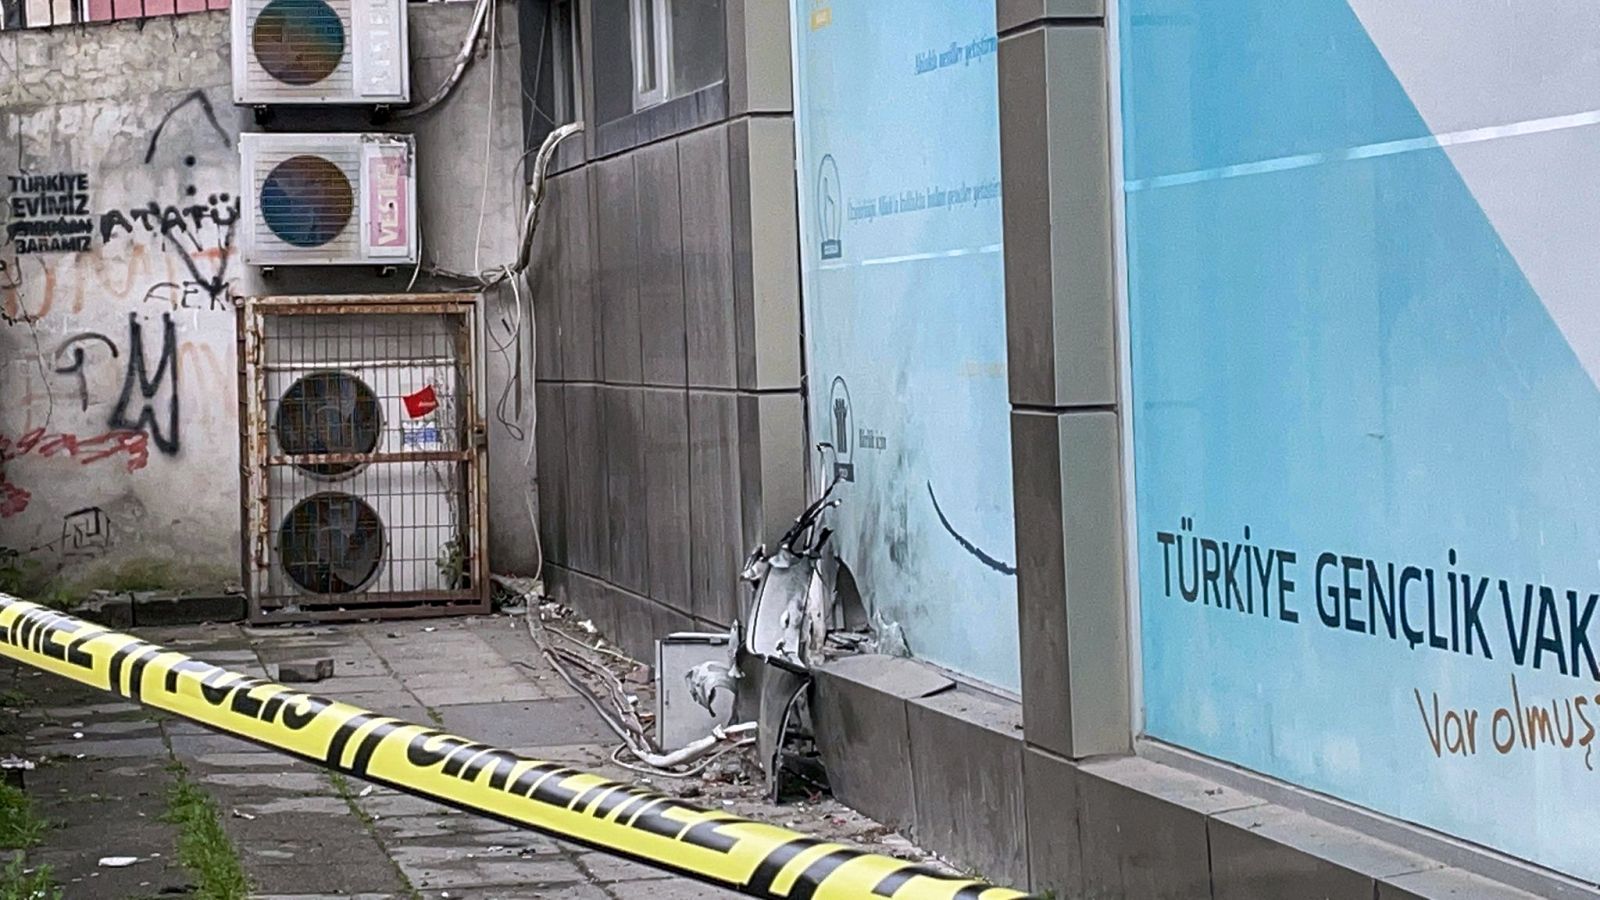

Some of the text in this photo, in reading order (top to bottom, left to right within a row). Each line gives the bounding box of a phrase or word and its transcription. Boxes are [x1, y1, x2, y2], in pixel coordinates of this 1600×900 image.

[99, 194, 241, 244] ATATÜ
[1156, 516, 1600, 682] TÜRKİYE GENÇLİK VAK
[1414, 672, 1600, 771] Var olmuş
